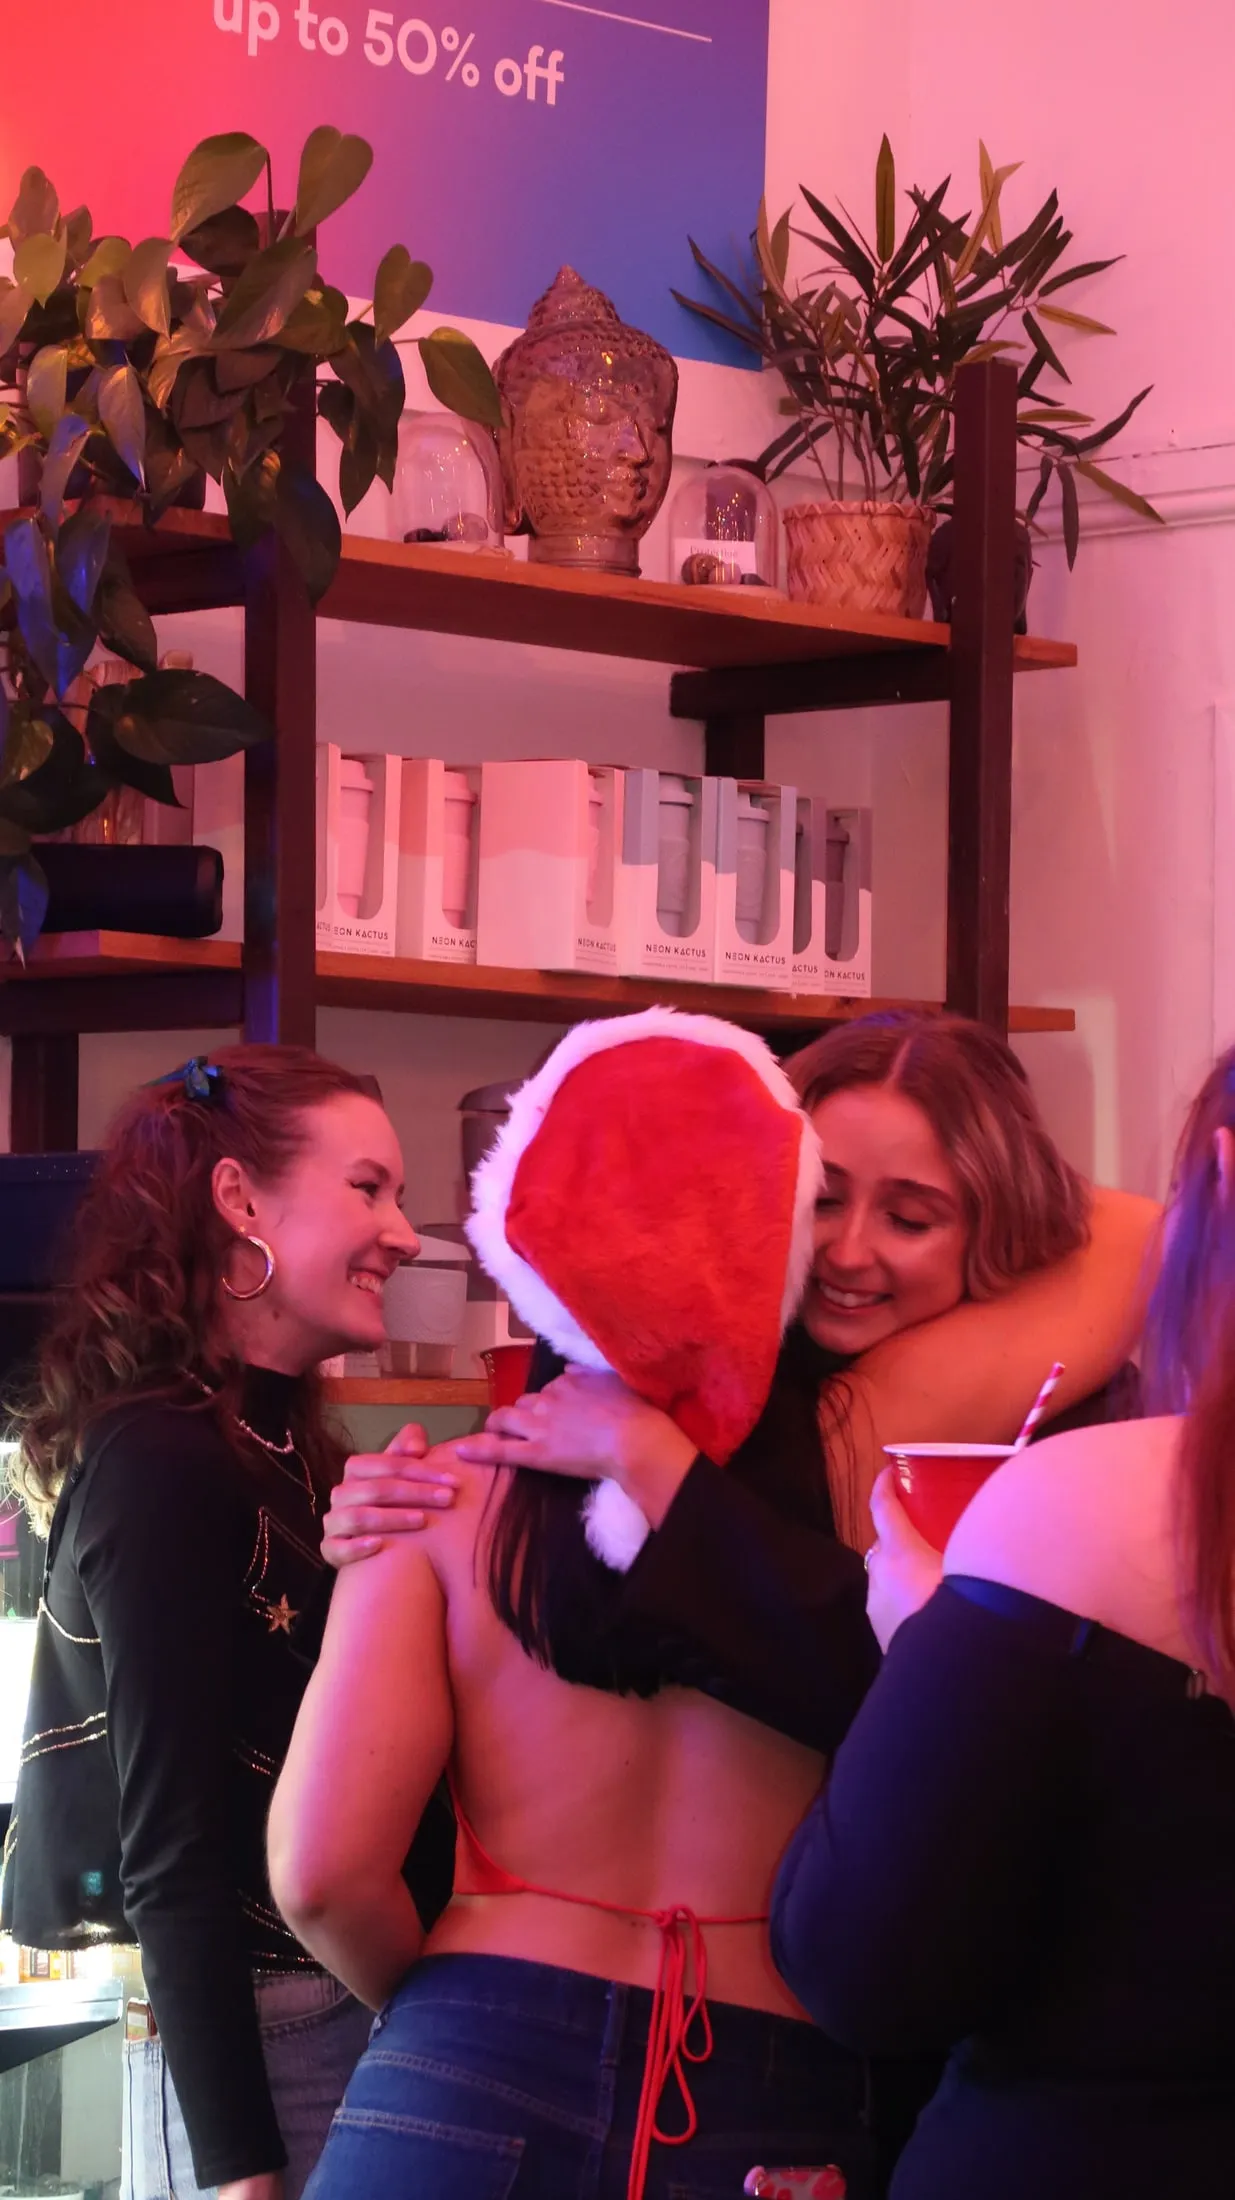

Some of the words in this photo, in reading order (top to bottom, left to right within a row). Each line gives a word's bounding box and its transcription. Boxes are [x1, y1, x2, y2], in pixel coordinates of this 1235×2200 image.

[213, 0, 280, 56] up
[294, 0, 349, 56] to
[363, 9, 480, 88] 50%
[494, 45, 565, 105] off
[333, 926, 352, 936] EON
[355, 929, 389, 940] KACTUS
[431, 936, 456, 946] NEON
[459, 939, 476, 949] KAC
[577, 938, 595, 949] NEON
[595, 942, 617, 953] KACTUS
[645, 944, 671, 955] NEON
[674, 947, 706, 958] KACTUS
[725, 951, 750, 961] NEON
[753, 954, 786, 965] KACTUS
[792, 964, 818, 974] ACTUS
[837, 971, 866, 981] KACTUS
